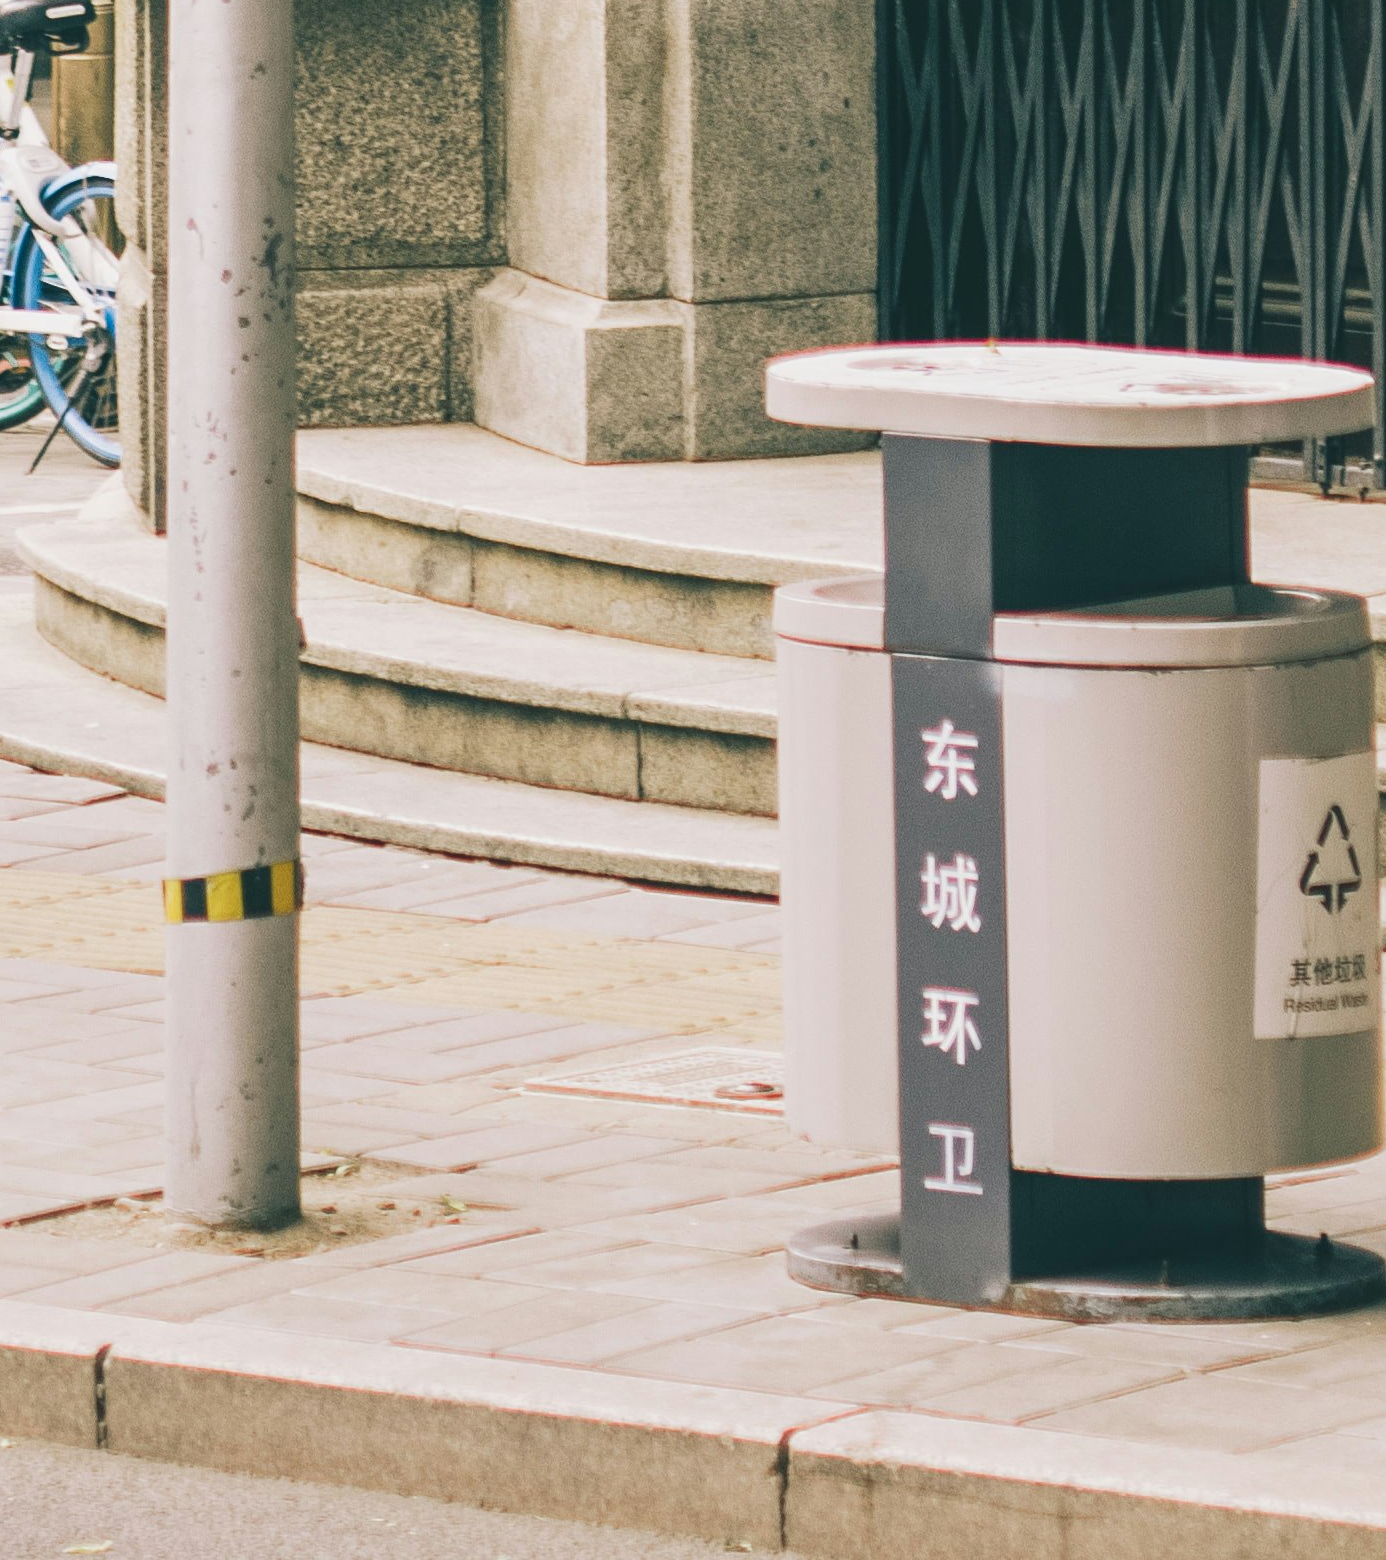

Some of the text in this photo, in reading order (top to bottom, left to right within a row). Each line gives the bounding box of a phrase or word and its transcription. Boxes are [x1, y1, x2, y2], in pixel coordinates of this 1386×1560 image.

[920, 719, 985, 1197] 东城环卫
[1290, 953, 1367, 987] 其他垃圾
